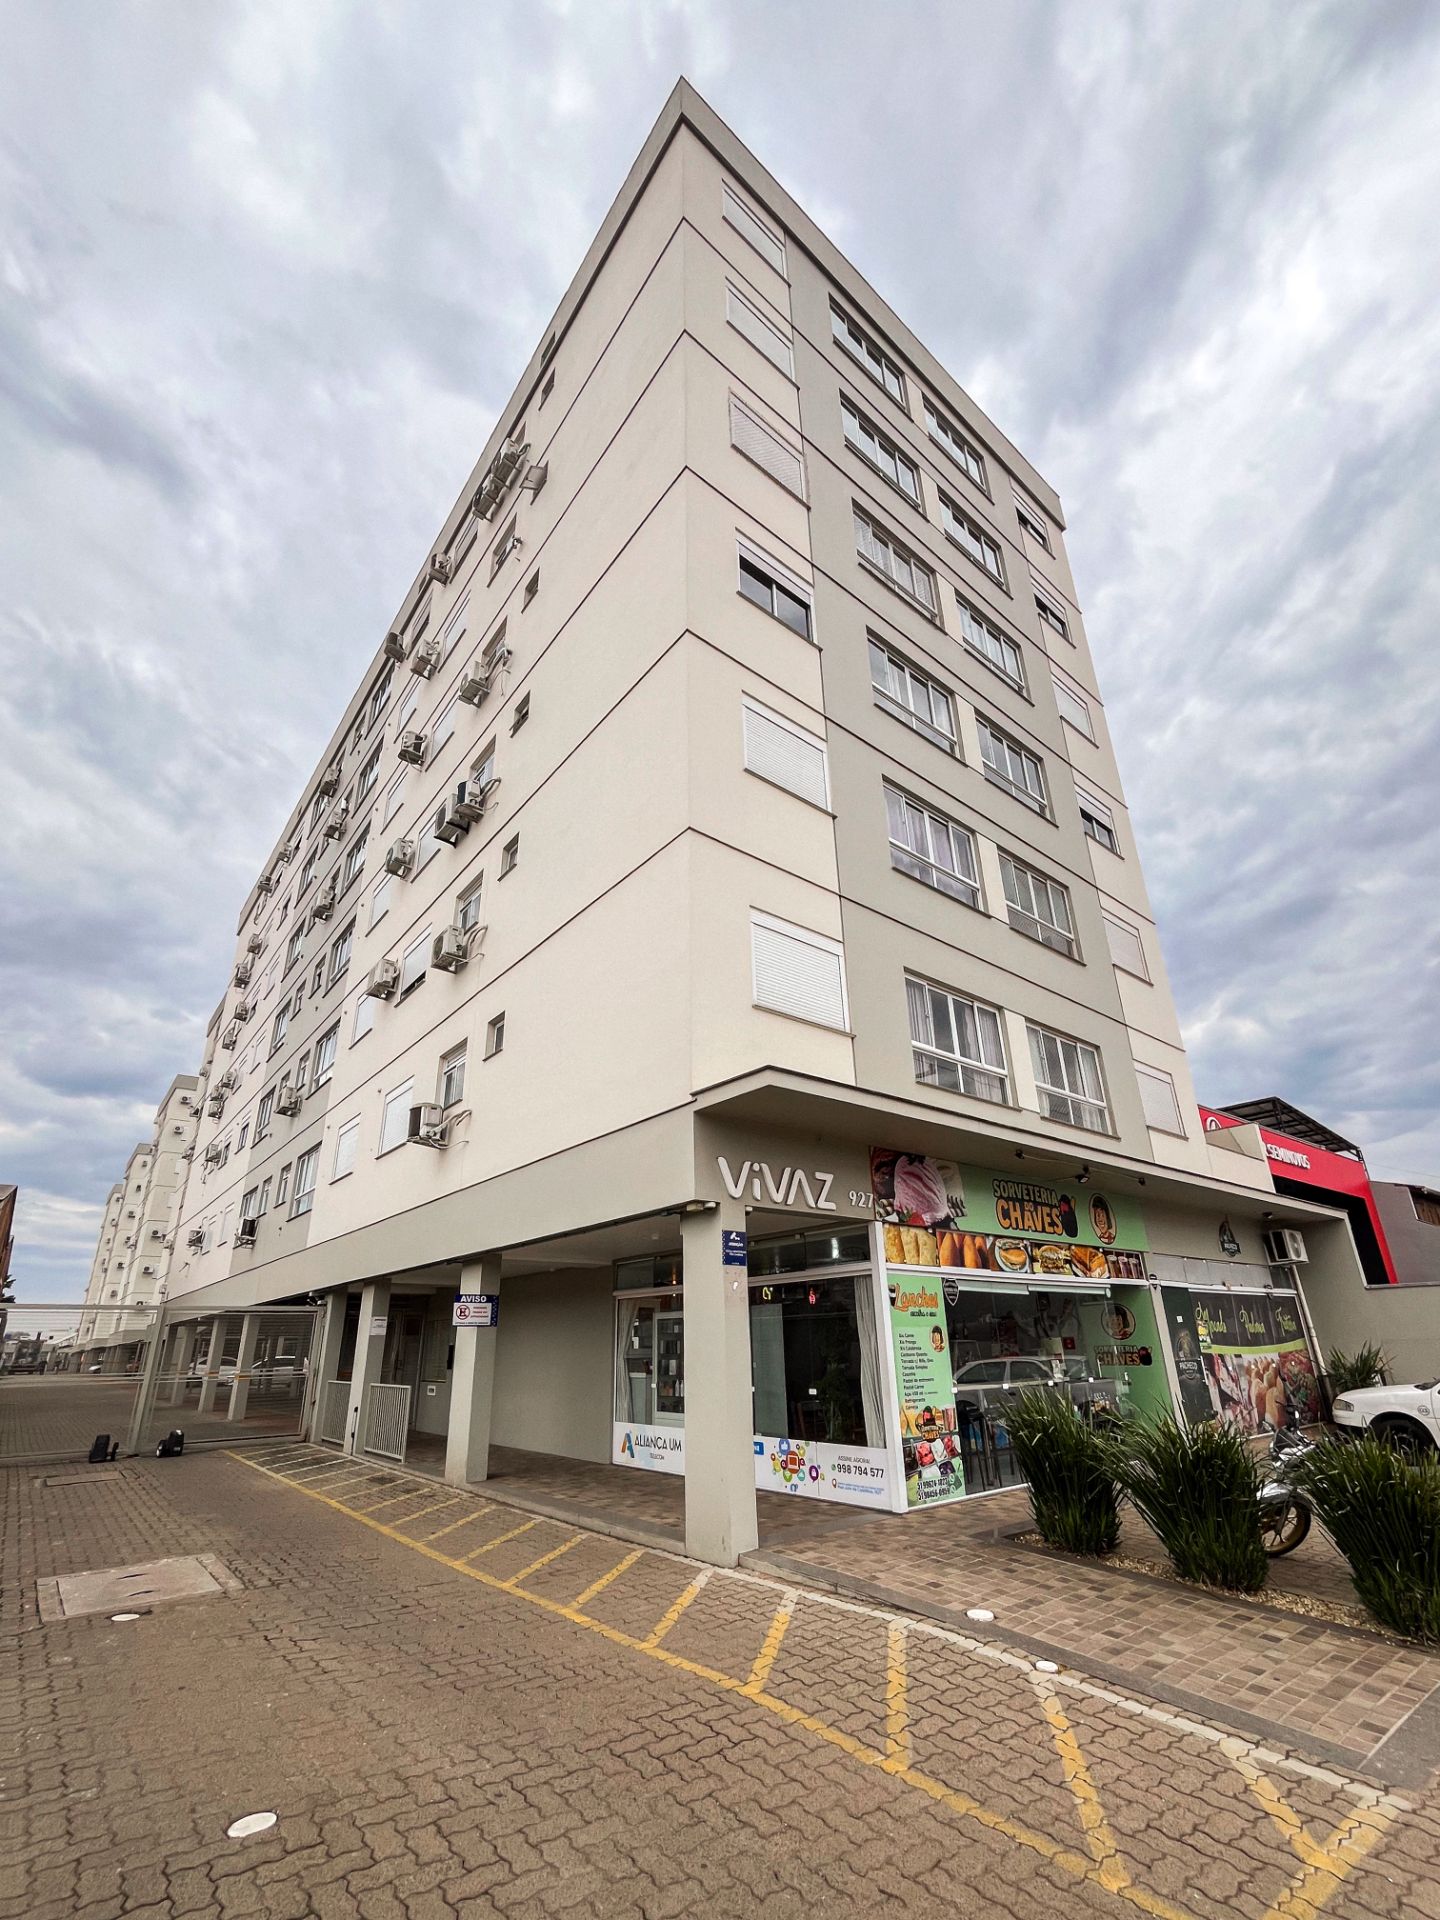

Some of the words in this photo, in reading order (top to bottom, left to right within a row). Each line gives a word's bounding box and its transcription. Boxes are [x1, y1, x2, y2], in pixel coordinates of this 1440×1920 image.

[849, 1190, 873, 1209] 927
[992, 1180, 1059, 1206] SORVETERIA
[996, 1198, 1064, 1235] CHAVES
[460, 1295, 487, 1303] AVISO
[669, 1438, 682, 1452] UM
[836, 1463, 851, 1474] 998
[853, 1465, 868, 1476] 794
[870, 1467, 884, 1478] 577
